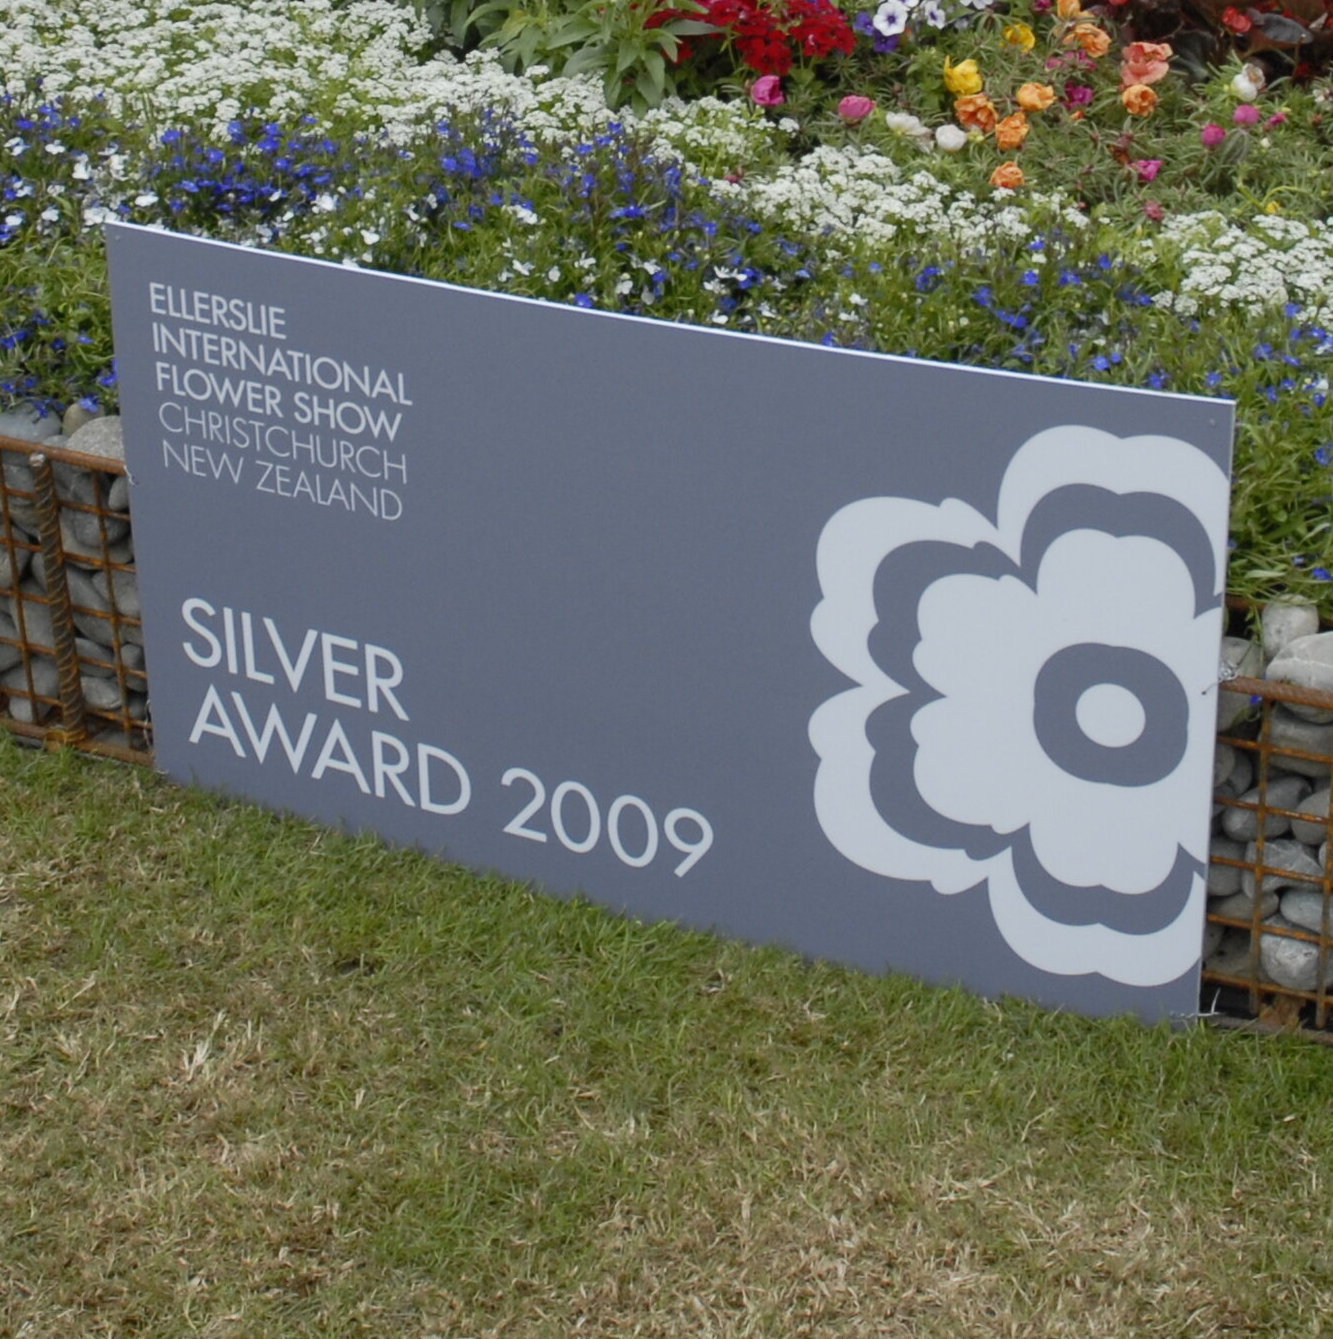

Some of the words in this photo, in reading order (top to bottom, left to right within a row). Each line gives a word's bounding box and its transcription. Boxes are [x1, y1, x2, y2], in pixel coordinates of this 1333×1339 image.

[149, 282, 287, 339] ELLERSLIE
[152, 322, 413, 405] INTERNATIONAL
[156, 361, 284, 418] FLOWER
[293, 391, 402, 442] SHOW
[158, 402, 407, 484] CHRISTCHURCH
[163, 439, 244, 484] NEW
[255, 460, 403, 520] ZEALAND
[181, 597, 410, 722] SILVER
[189, 683, 472, 816] AWARD
[500, 766, 714, 878] 2009
